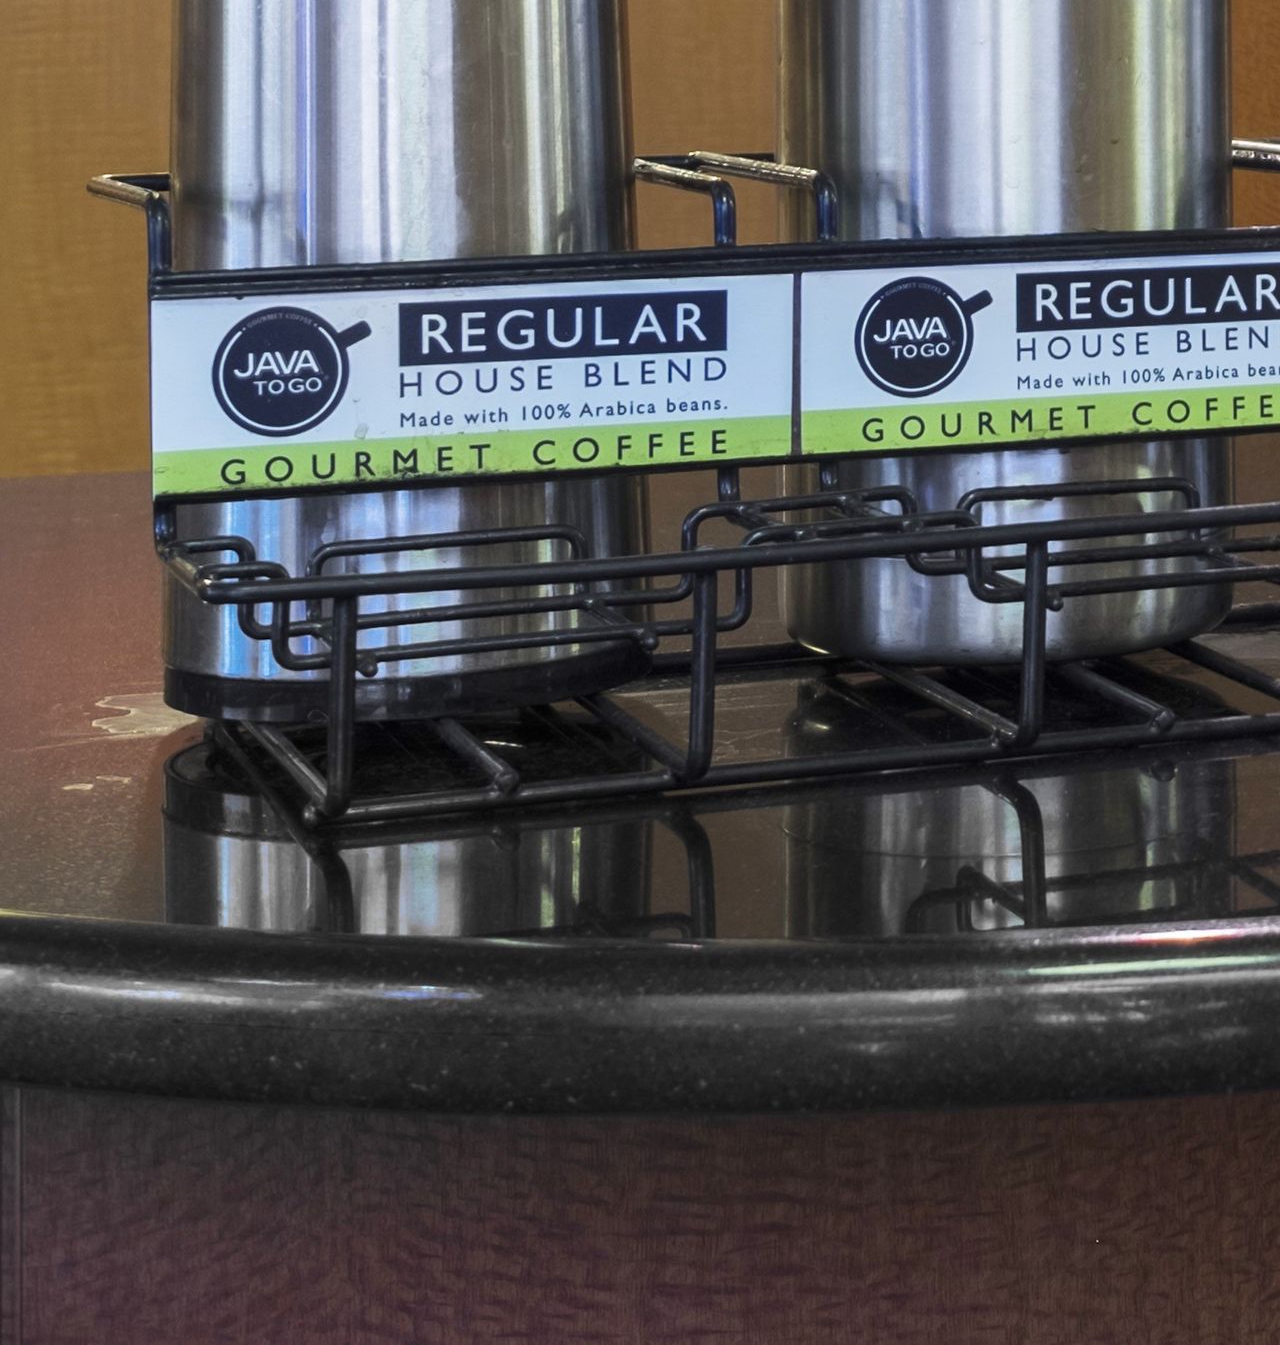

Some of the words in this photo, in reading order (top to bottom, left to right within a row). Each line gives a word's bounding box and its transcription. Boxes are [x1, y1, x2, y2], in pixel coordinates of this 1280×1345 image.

[420, 302, 708, 355] REGULAR
[873, 316, 948, 343] JAVA
[890, 344, 917, 359] TO
[920, 342, 950, 357] GO
[1016, 332, 1150, 362] HOUSE
[233, 349, 319, 378] JAVA
[399, 365, 554, 398] HOUSE
[584, 357, 728, 389] BLEND
[1017, 373, 1065, 391] Made
[1073, 370, 1112, 388] with
[1122, 367, 1166, 385] 100%
[1172, 364, 1239, 383] Arabica
[253, 380, 285, 396] TO
[288, 377, 323, 393] GO
[399, 410, 455, 429] Made
[464, 406, 509, 425] with
[521, 402, 571, 422] 100%
[579, 397, 657, 418] Arabica
[666, 396, 729, 415] beans.
[862, 404, 1097, 442] GOURMET
[220, 443, 493, 486] GOURMET
[532, 429, 729, 466] COFFEE
